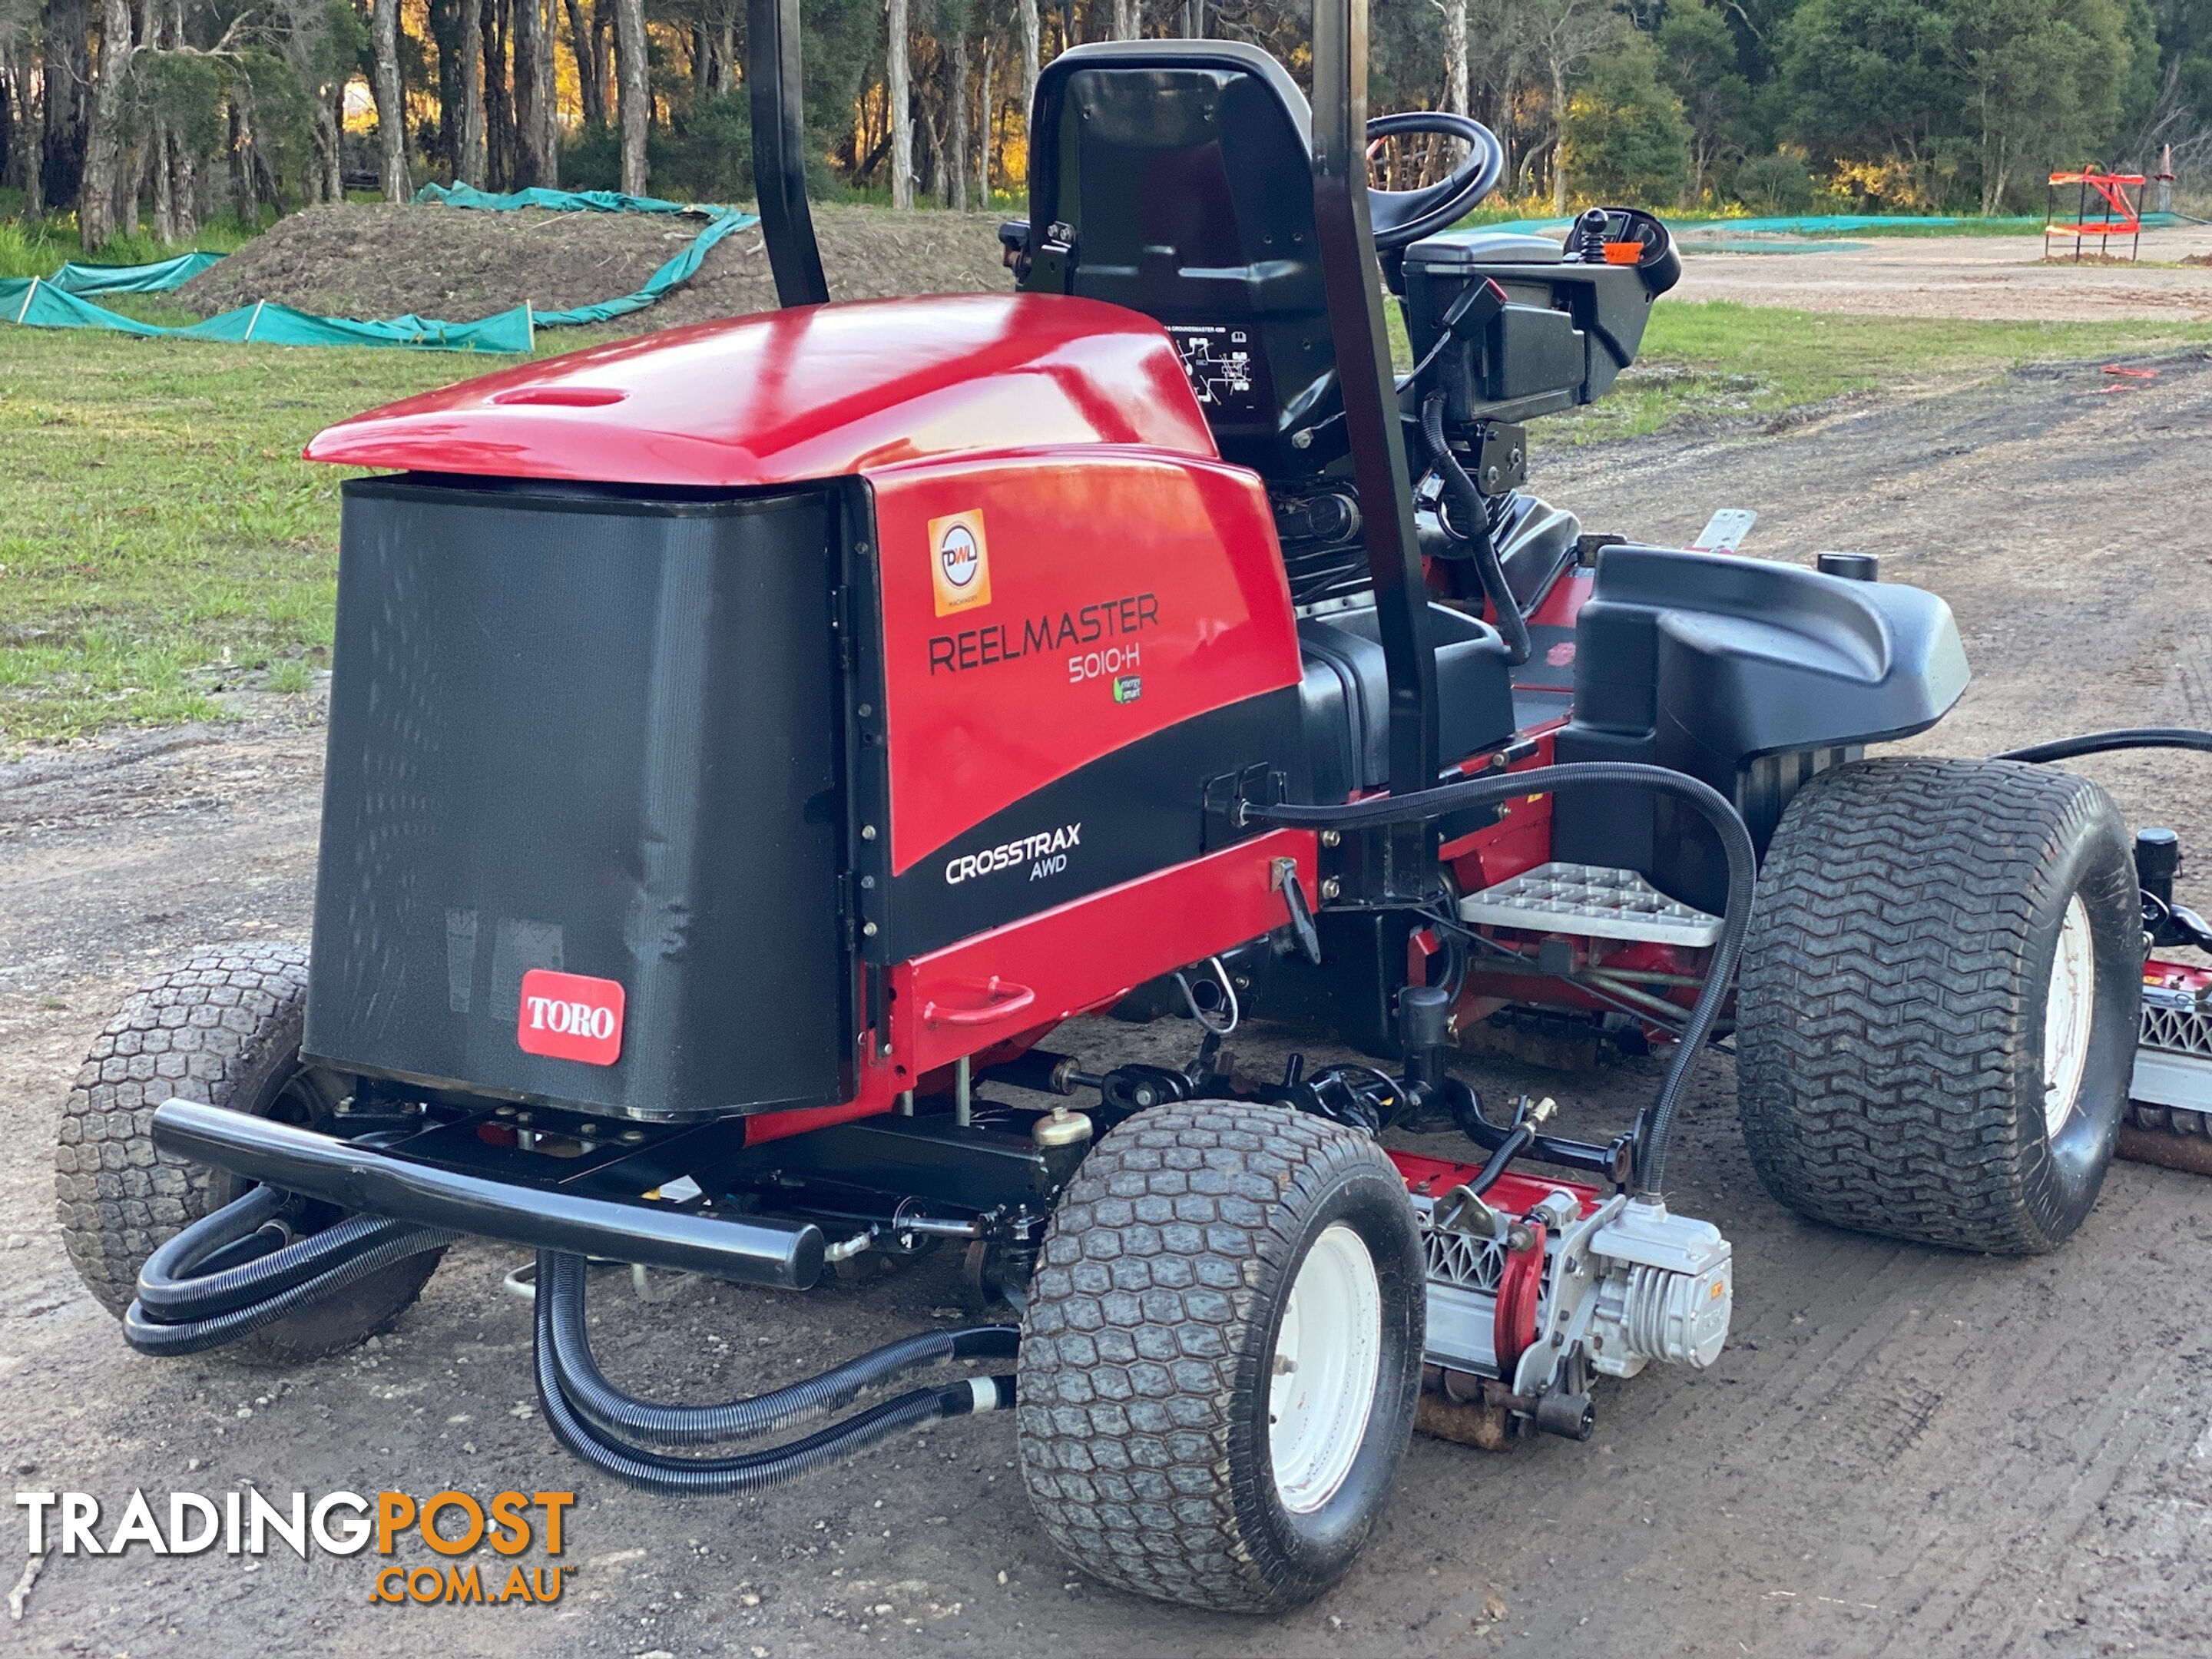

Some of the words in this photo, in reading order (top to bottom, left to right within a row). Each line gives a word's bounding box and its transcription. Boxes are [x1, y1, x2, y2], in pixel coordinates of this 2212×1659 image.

[942, 544, 977, 567] DWL
[929, 593, 1158, 676] REELMASTER
[945, 822, 1081, 884] CROSSTRAX
[1029, 853, 1068, 882] AWD
[527, 996, 614, 1040] TORO
